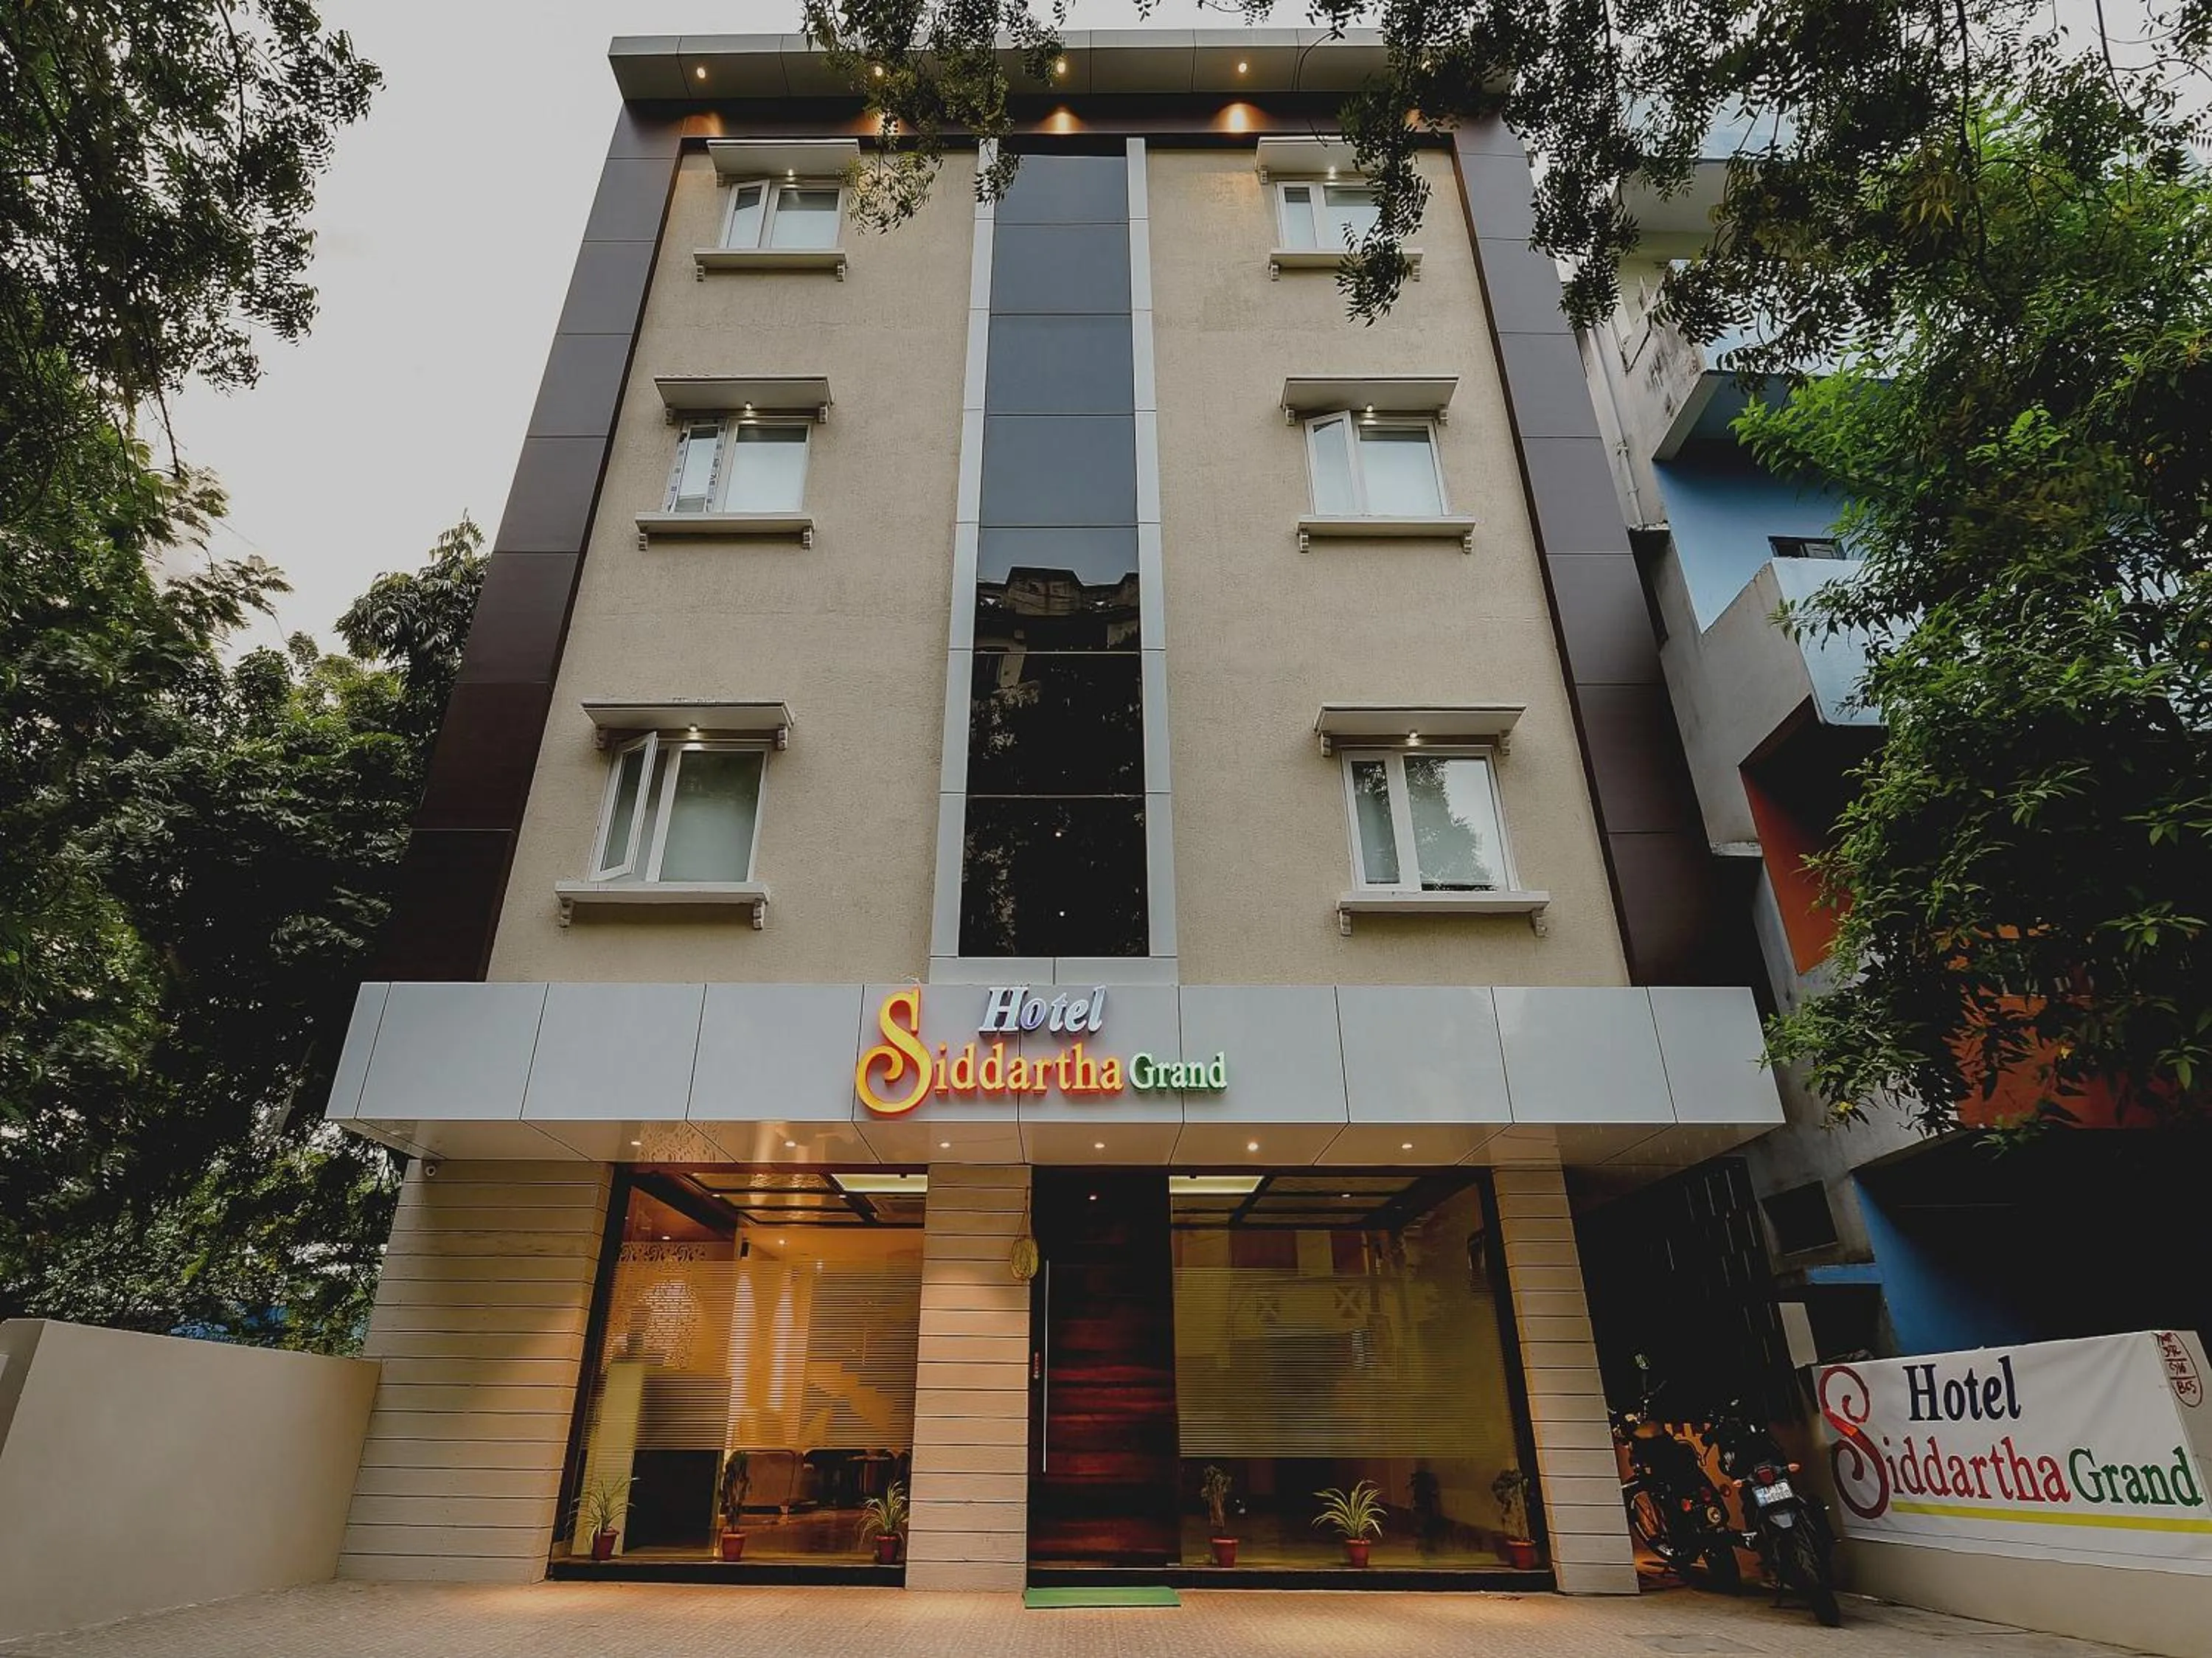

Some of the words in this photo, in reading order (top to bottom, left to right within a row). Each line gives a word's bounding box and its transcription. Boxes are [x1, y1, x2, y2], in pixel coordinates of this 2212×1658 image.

[855, 985, 1124, 1114] Siddartha
[1129, 1051, 1228, 1092] Grand
[978, 985, 1105, 1034] Hotel
[1902, 1355, 2022, 1422] Hotel
[1818, 1365, 2070, 1519] Siddartha
[2068, 1446, 2204, 1507] Grand
